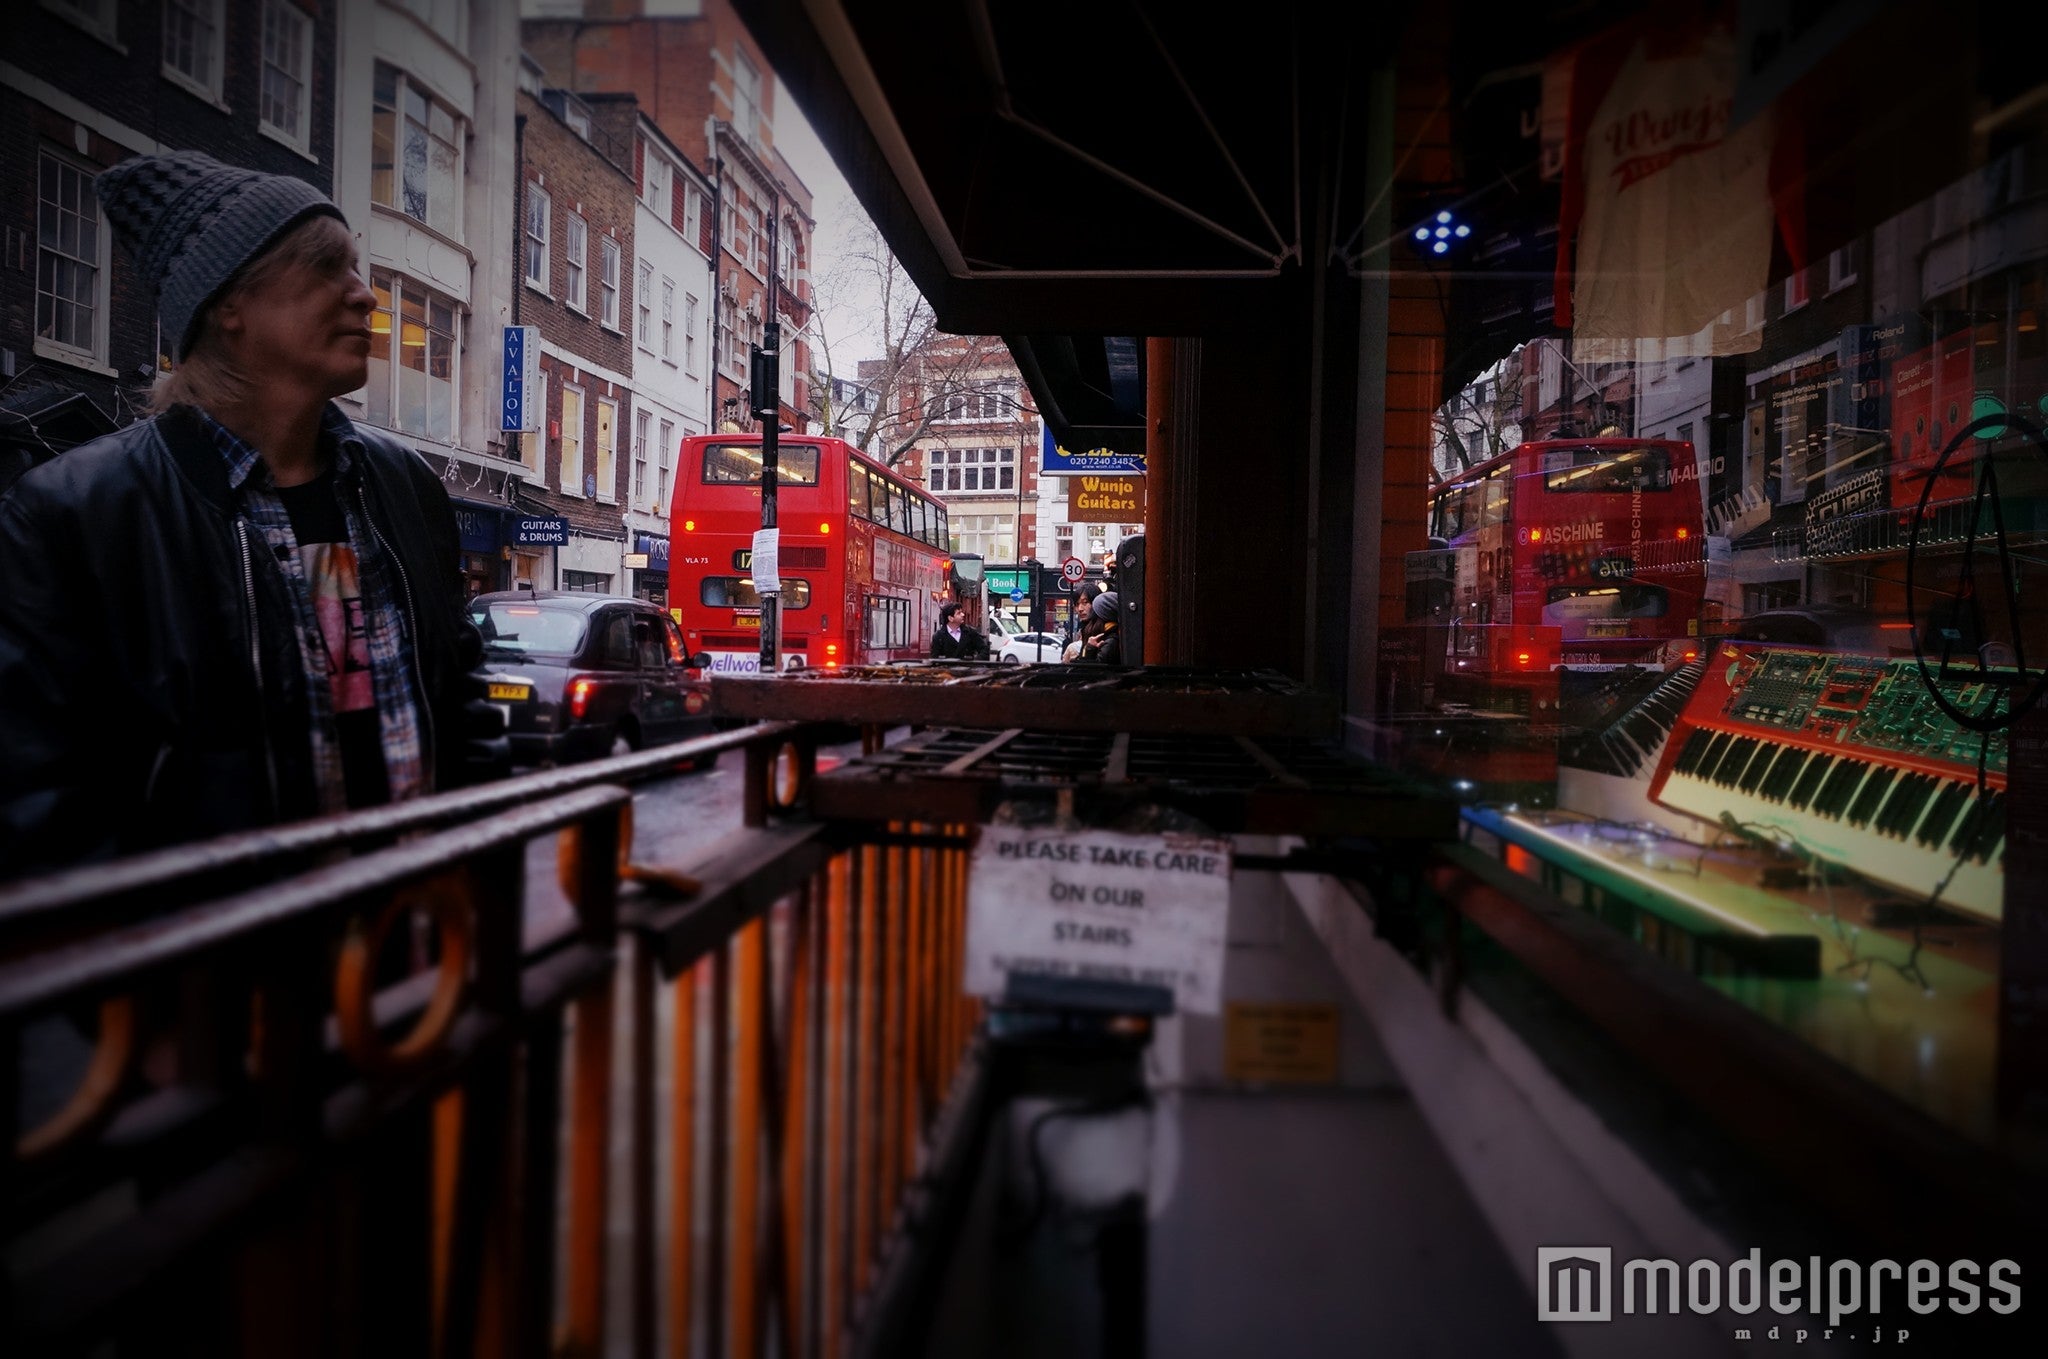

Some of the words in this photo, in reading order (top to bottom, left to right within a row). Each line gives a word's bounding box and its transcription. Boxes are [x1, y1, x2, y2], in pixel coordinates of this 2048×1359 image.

[1872, 323, 1905, 342] Roland
[506, 330, 519, 427] AVALON
[1070, 457, 1087, 465] 020
[1089, 457, 1110, 465] 7240
[1666, 455, 1725, 486] M-AUDIO
[1081, 476, 1134, 496] Wunjo
[1077, 492, 1136, 510] Guitars
[521, 520, 561, 530] GUITARS
[1532, 522, 1604, 545] ASCHINE
[519, 532, 528, 542] &
[529, 532, 563, 542] DRUMS
[741, 552, 753, 569] 17
[1065, 564, 1083, 576] 30
[1000, 841, 1081, 863] PLEASE
[1088, 846, 1147, 868] TAKE
[1153, 852, 1215, 875] CARE
[1051, 881, 1086, 903] ON
[1092, 886, 1145, 908] OUR
[1054, 922, 1133, 947] STAIRS
